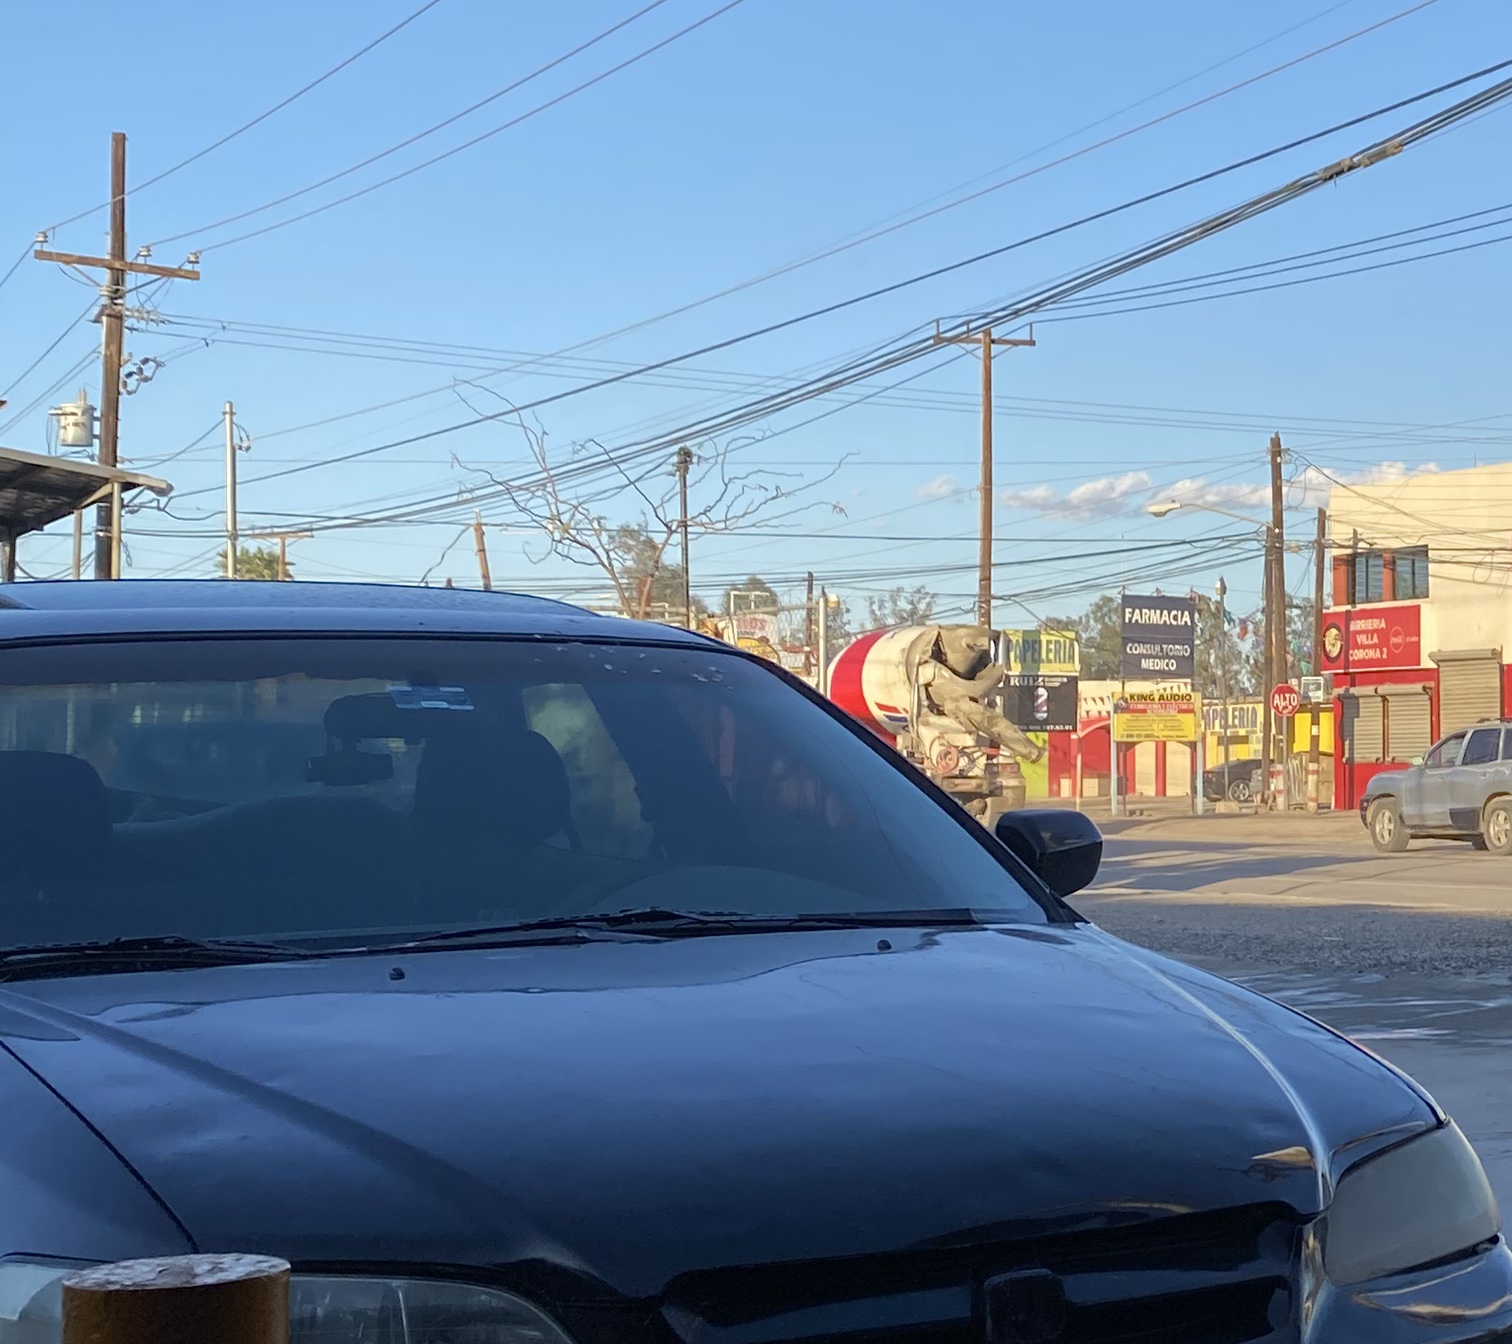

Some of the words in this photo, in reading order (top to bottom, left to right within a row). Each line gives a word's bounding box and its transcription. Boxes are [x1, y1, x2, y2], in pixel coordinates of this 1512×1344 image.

[1125, 608, 1191, 626] FARMACIA
[1356, 632, 1379, 645] VILLA
[1126, 643, 1191, 657] CONSULTORIO
[1349, 647, 1381, 661] CORONA
[1382, 647, 1389, 659] 2
[1141, 658, 1177, 671] MEDICO
[1130, 693, 1155, 702] KING
[1158, 693, 1193, 702] AUDIO
[1273, 693, 1298, 707] ALTO
